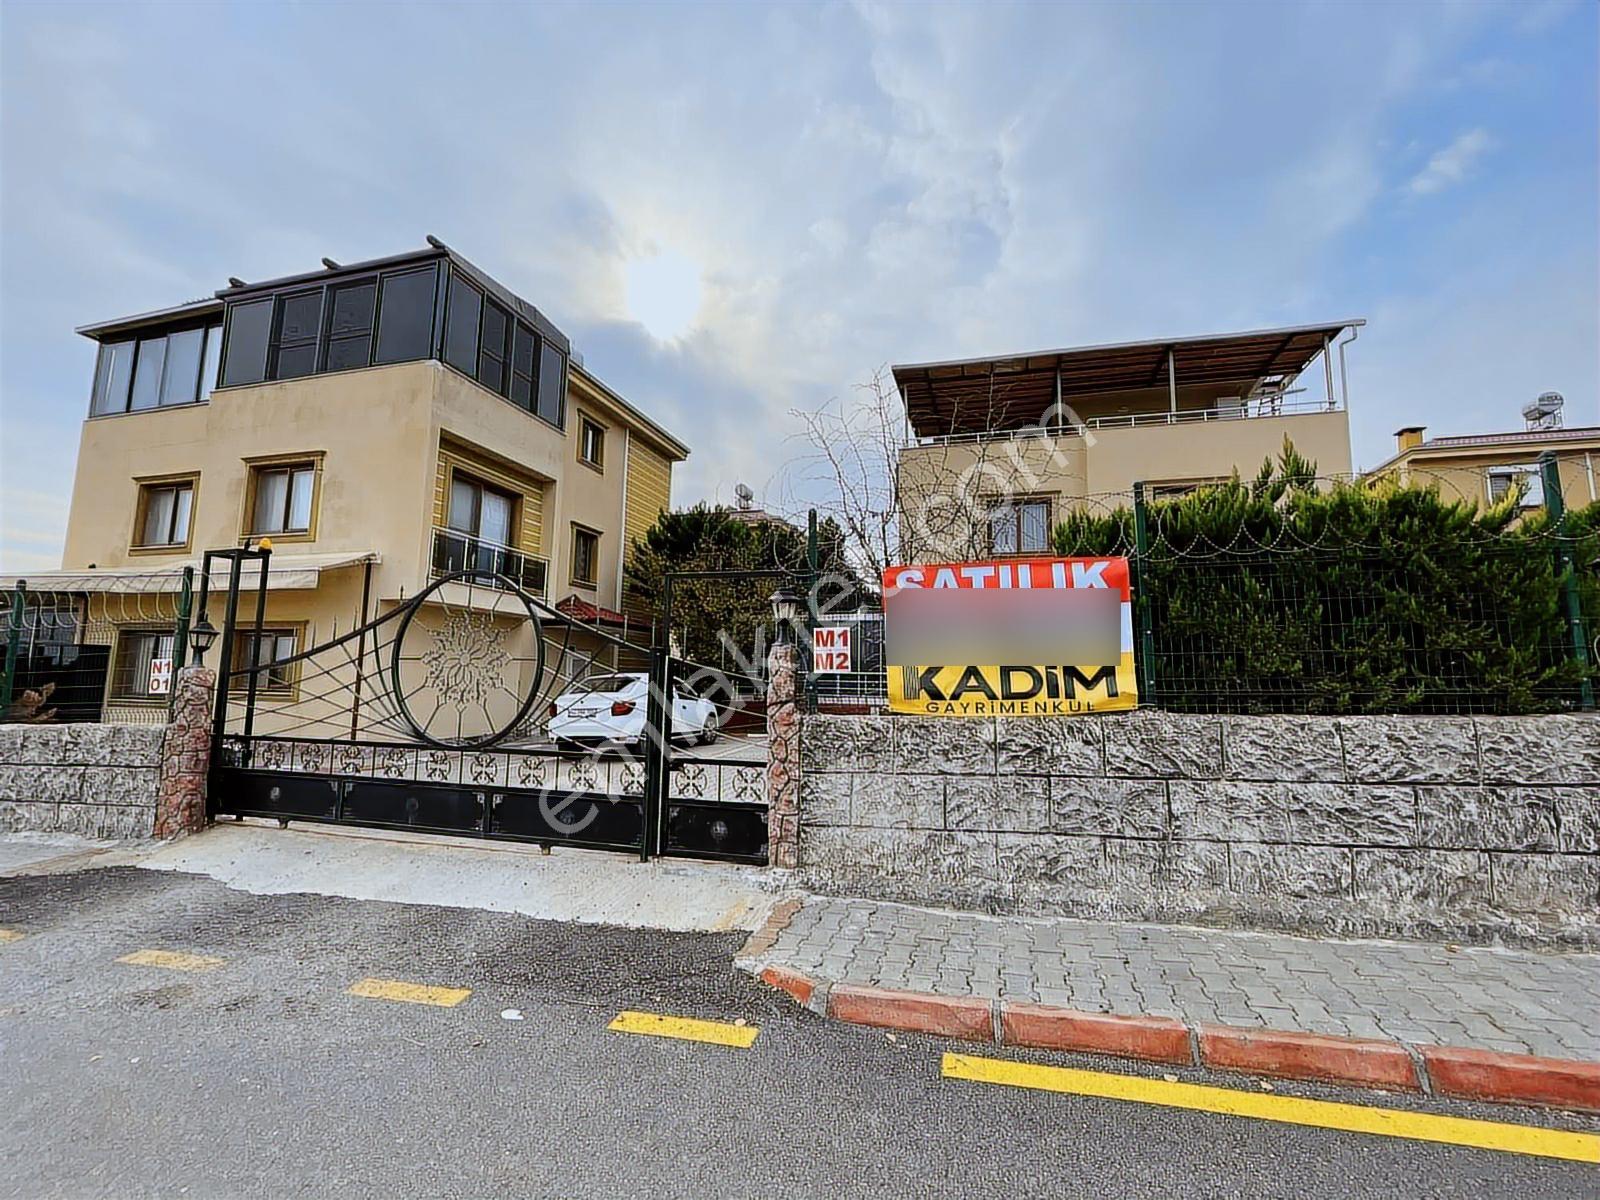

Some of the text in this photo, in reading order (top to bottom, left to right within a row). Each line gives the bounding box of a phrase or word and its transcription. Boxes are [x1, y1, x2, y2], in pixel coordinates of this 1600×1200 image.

[815, 629, 849, 648] M1
[152, 660, 171, 674] N1
[816, 652, 850, 670] M2
